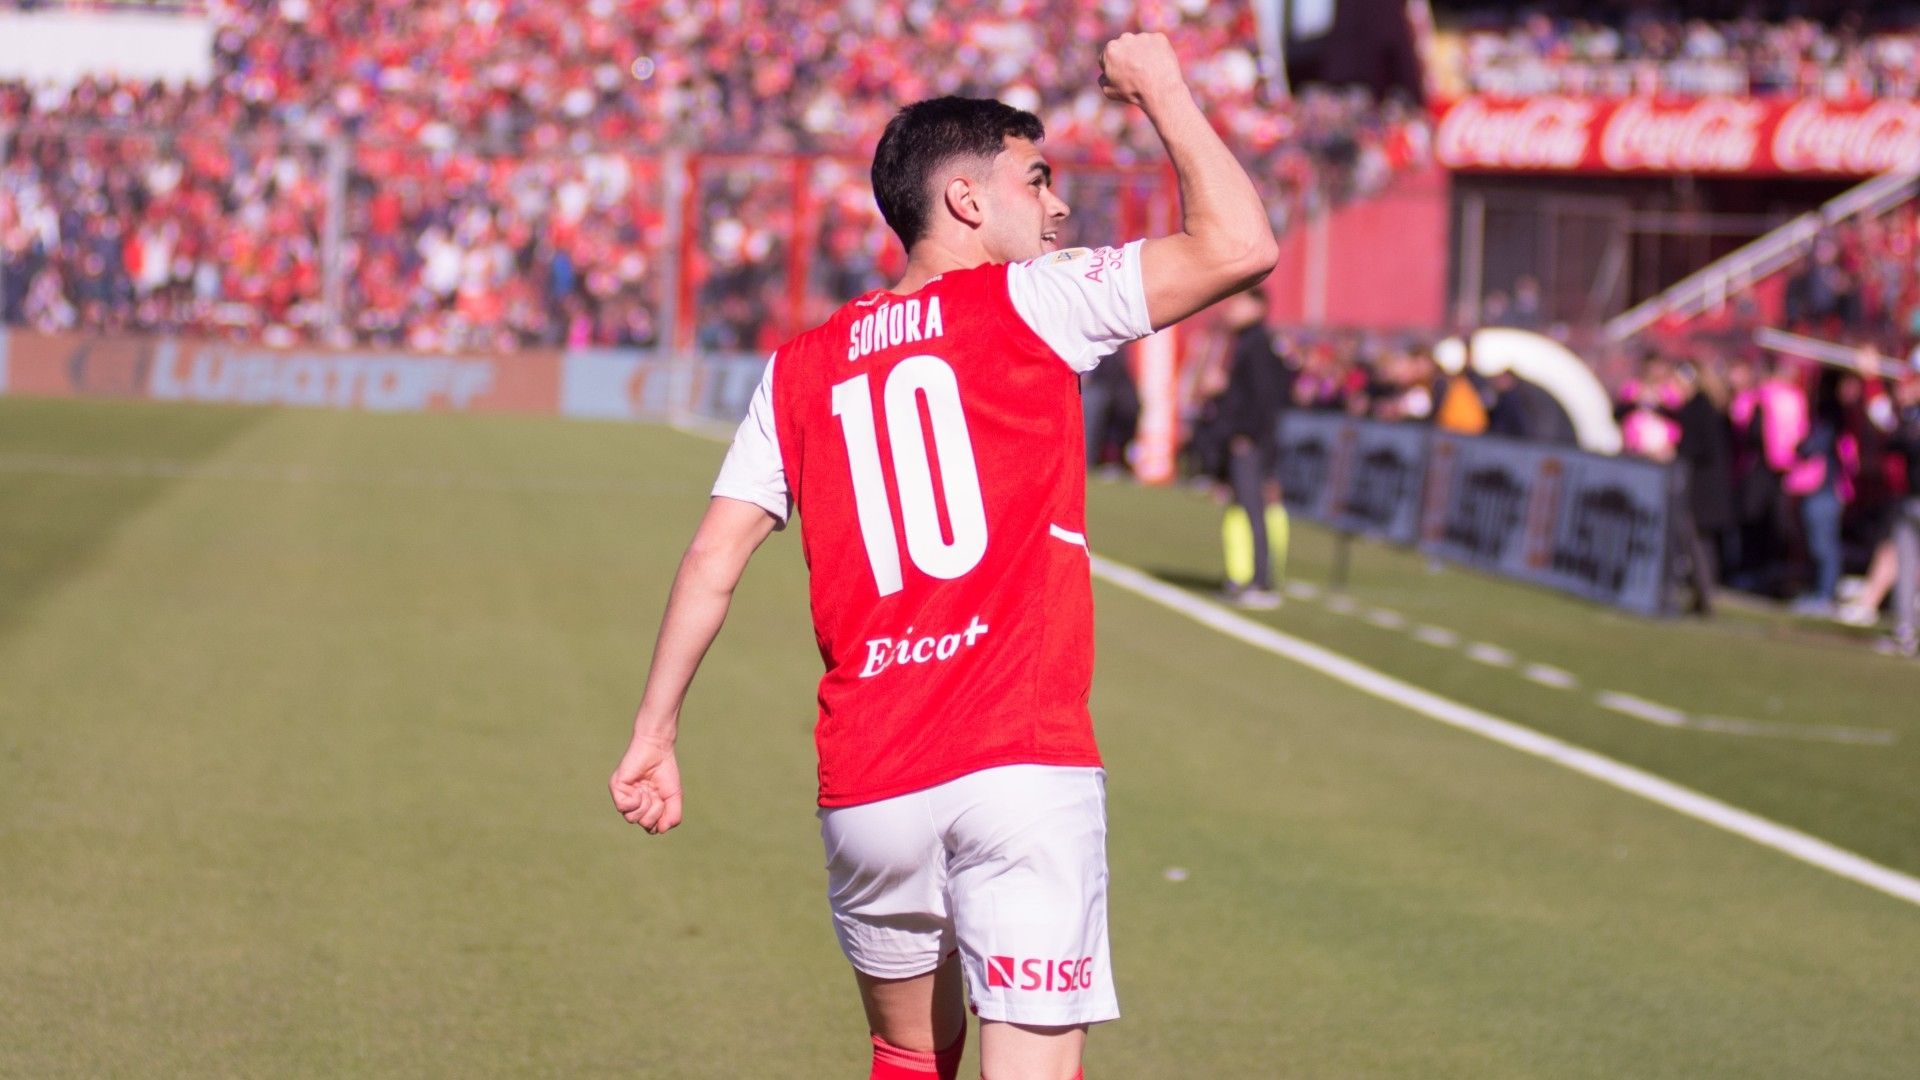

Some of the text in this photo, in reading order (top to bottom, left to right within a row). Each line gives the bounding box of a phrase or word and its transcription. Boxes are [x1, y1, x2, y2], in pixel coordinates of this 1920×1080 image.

[848, 296, 944, 361] SOÑORA
[832, 355, 989, 597] 10
[1020, 956, 1093, 992] SISEG
